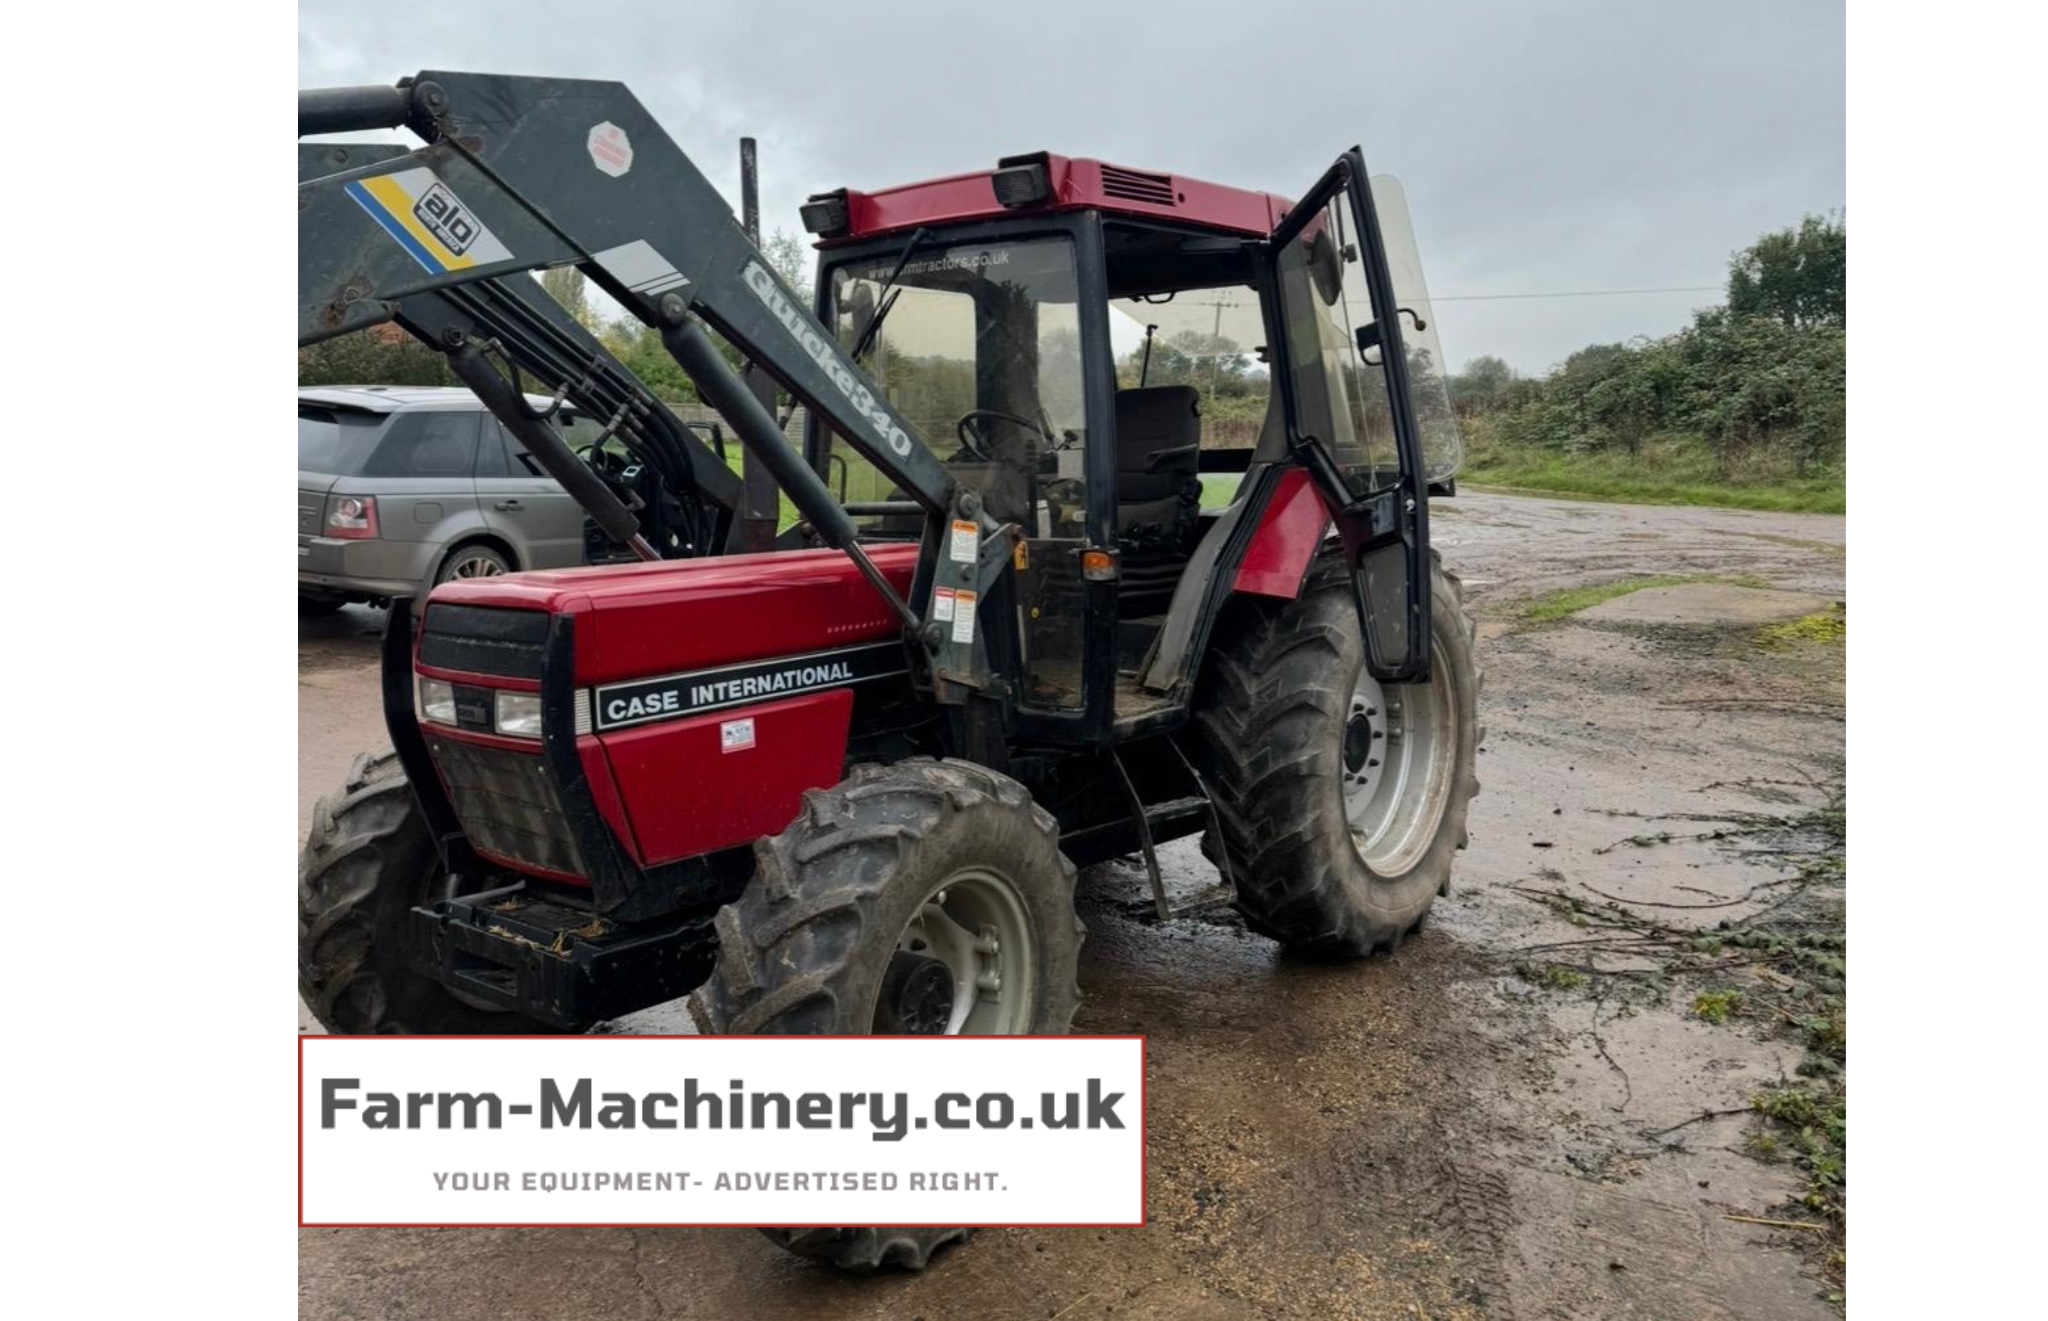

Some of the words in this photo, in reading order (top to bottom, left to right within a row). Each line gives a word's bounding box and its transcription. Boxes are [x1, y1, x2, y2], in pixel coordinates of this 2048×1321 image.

[423, 192, 473, 244] alo
[607, 690, 680, 720] CASE
[690, 661, 853, 706] INTERNATIONAL
